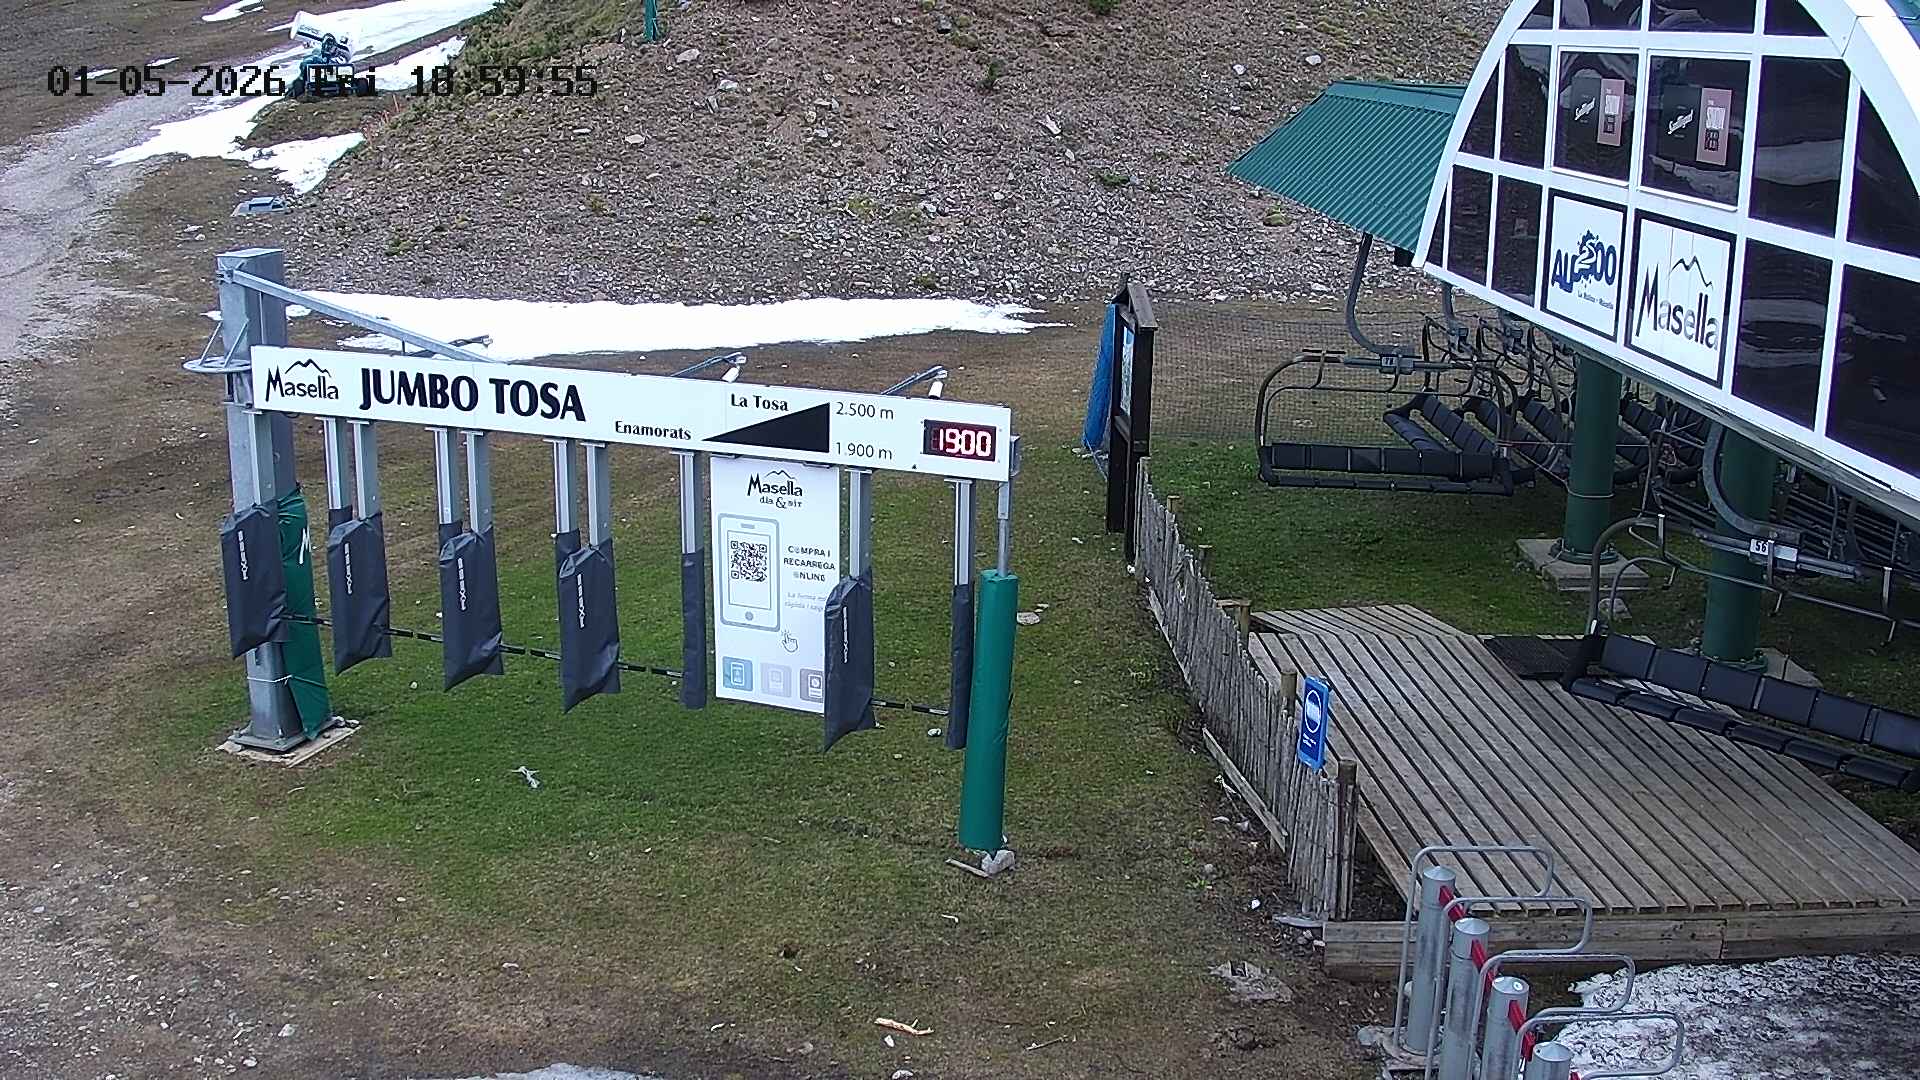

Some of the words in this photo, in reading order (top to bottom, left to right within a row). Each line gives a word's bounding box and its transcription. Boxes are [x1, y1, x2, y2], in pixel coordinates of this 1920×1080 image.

[1635, 263, 1720, 350] Masella
[266, 366, 339, 402] Masella
[359, 367, 479, 411] JUMBO
[489, 378, 586, 422] TOSA
[731, 393, 748, 408] La
[753, 395, 789, 411] Tosa
[836, 401, 876, 418] 2.500
[880, 408, 894, 420] m
[615, 420, 692, 441] Enamorats
[836, 442, 874, 458] 1.900
[879, 449, 893, 460] m
[747, 473, 803, 497] Masella
[1755, 541, 1767, 553] 56
